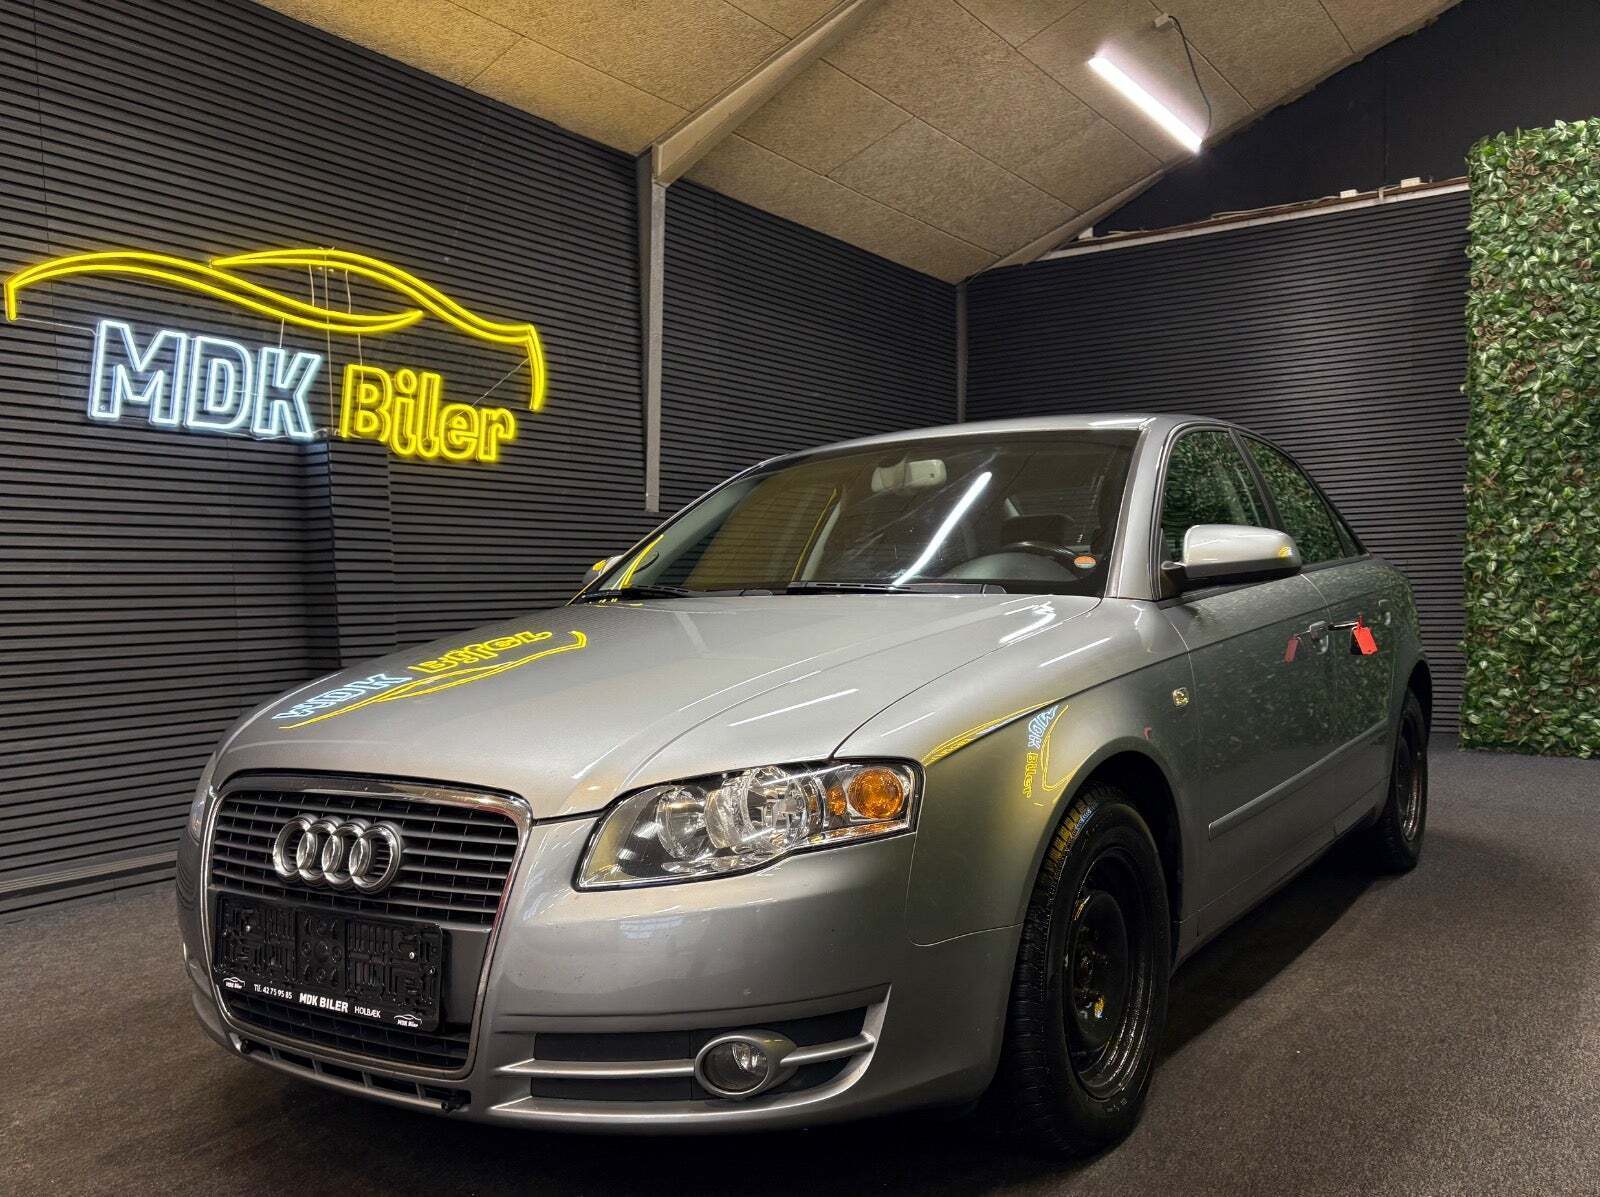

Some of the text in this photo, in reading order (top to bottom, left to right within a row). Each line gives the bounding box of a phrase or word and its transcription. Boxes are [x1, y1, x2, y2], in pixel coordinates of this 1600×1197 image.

[88, 319, 519, 463] MDK Biler
[263, 986, 270, 995] 42
[270, 988, 277, 996] 75
[277, 989, 285, 998] 95
[299, 992, 318, 1006] MDK
[319, 996, 349, 1013] BILER
[354, 1006, 381, 1018] HOLBÆK
